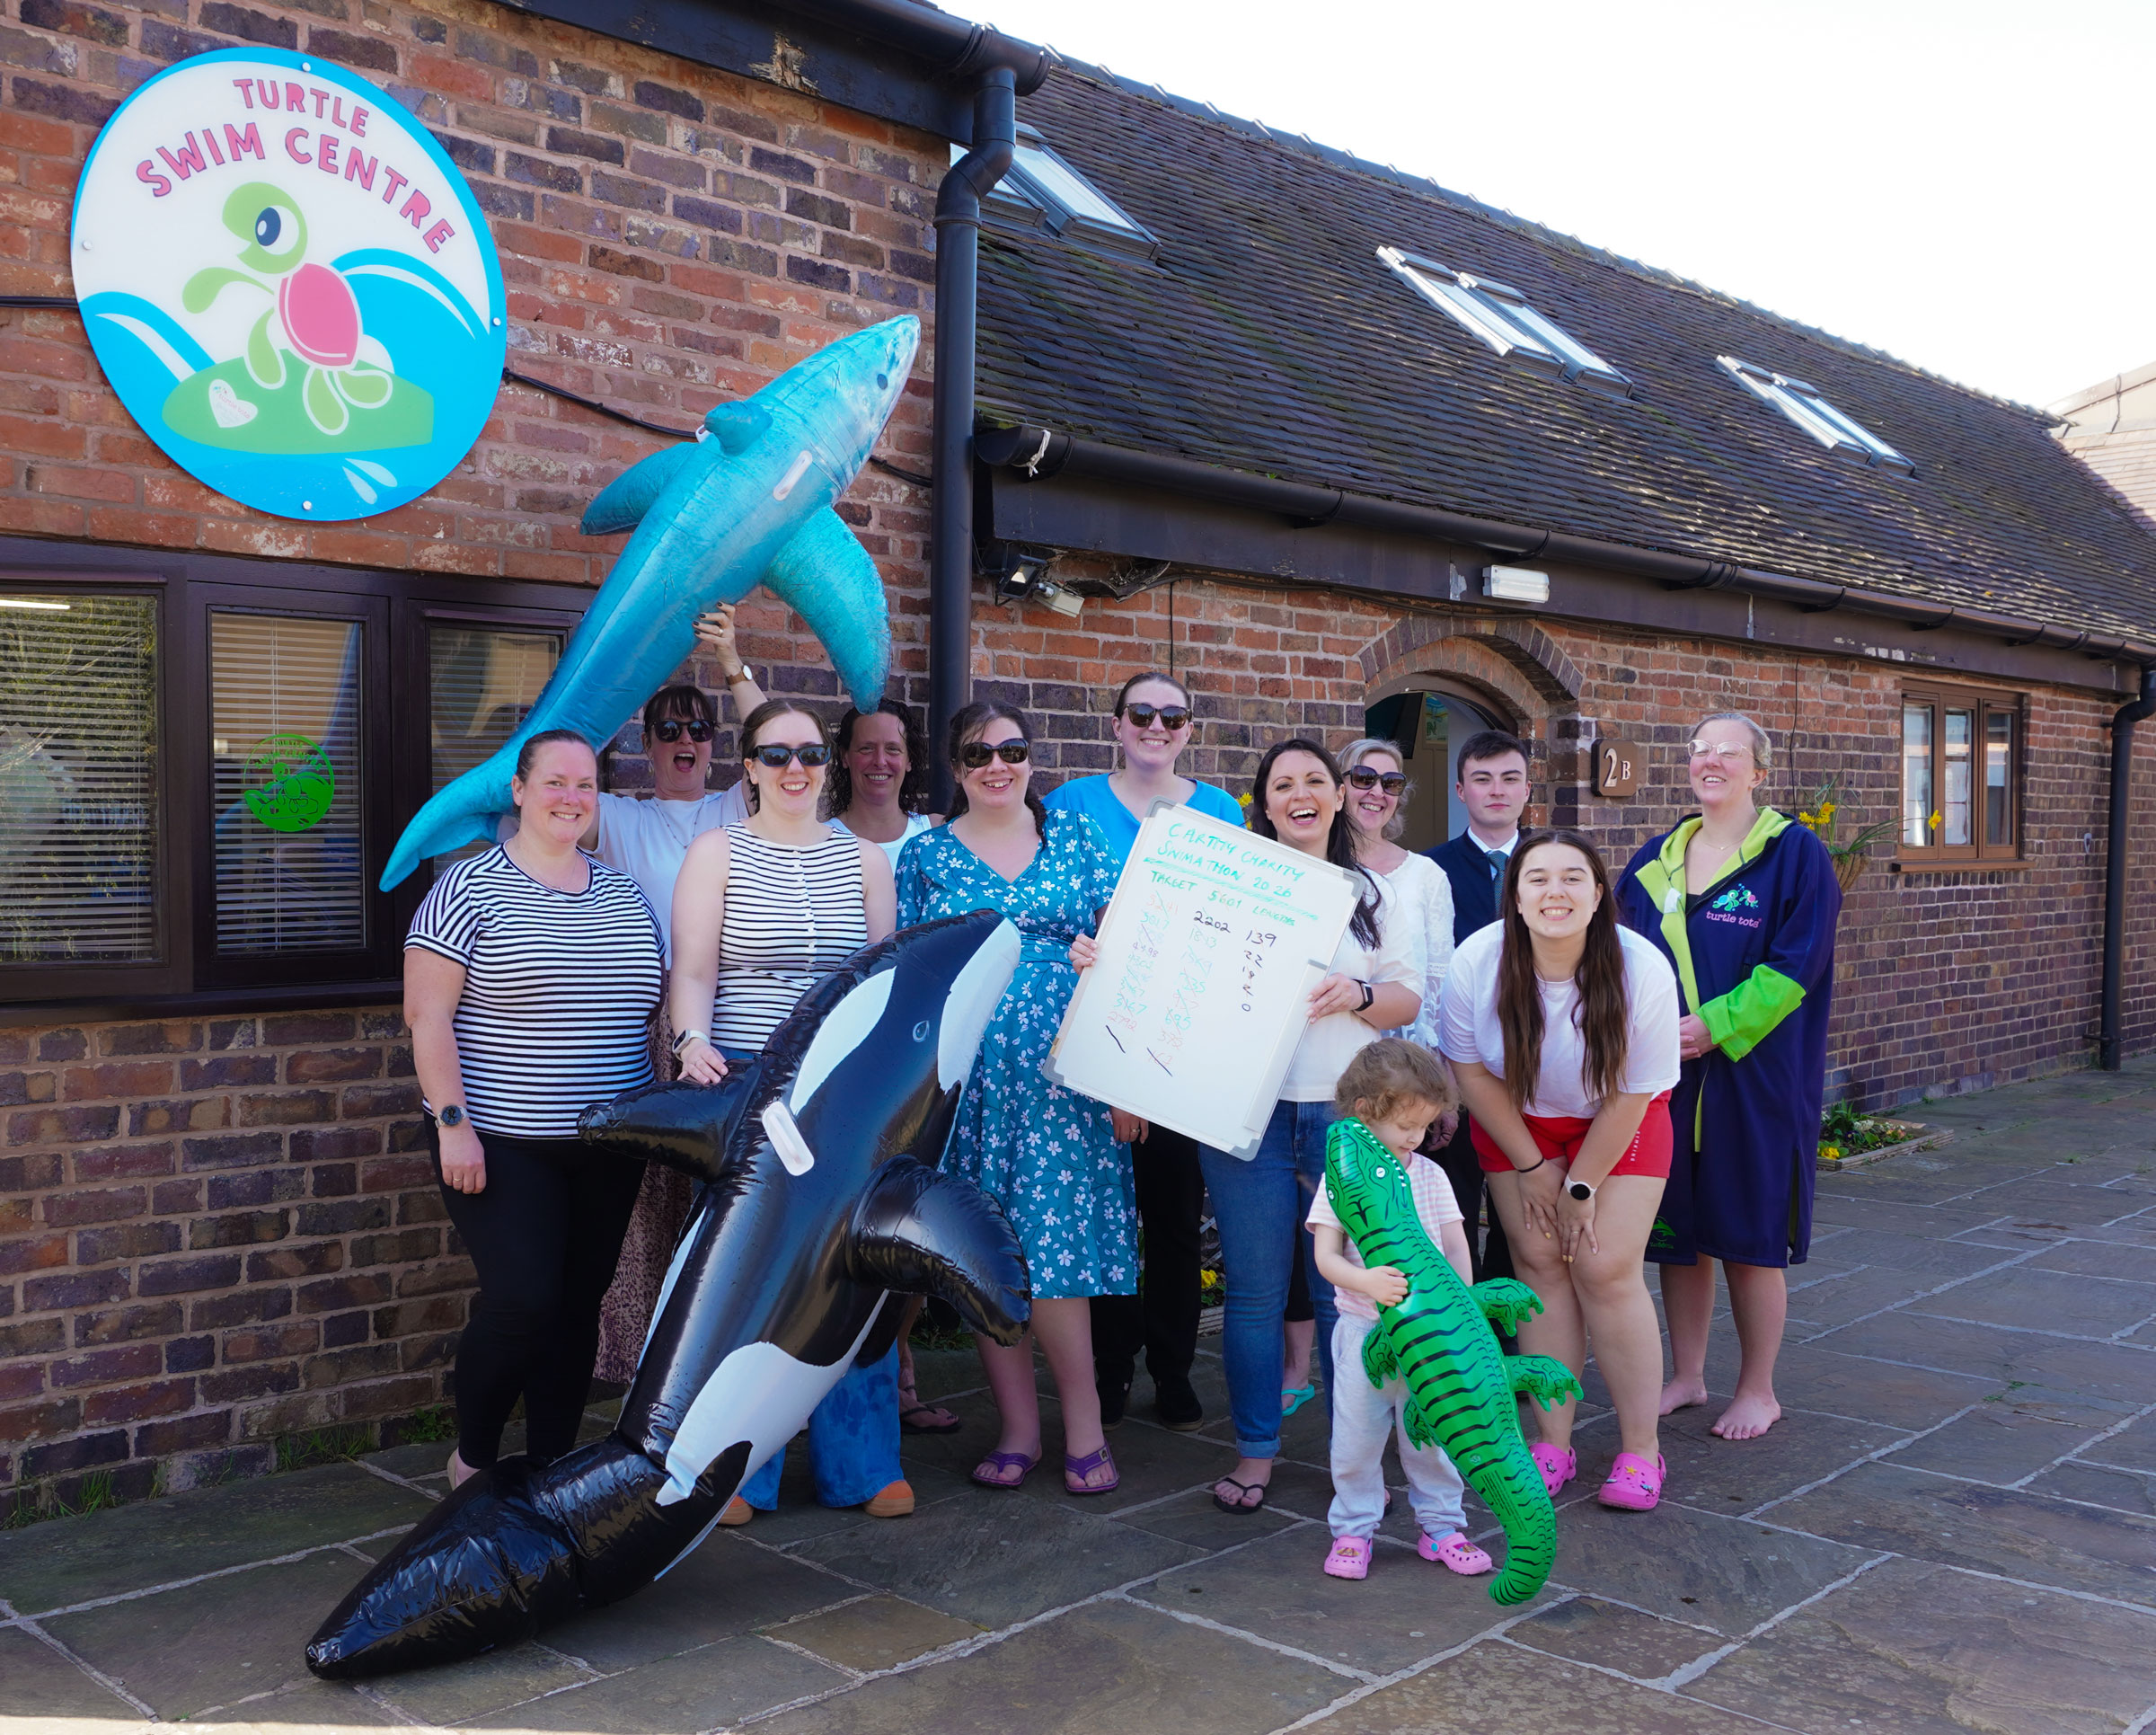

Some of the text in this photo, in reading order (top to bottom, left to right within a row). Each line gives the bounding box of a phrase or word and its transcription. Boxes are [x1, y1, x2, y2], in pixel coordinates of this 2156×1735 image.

[233, 78, 370, 138] TURTLE
[136, 121, 455, 254] SWIM CENTRE
[1241, 850, 1305, 881] CHARITY
[1150, 870, 1197, 891] TARGET
[1252, 905, 1296, 926] LENGTHS
[1193, 910, 1231, 933] 2202
[1706, 909, 1759, 928] turtle tots
[1246, 929, 1277, 948] 139
